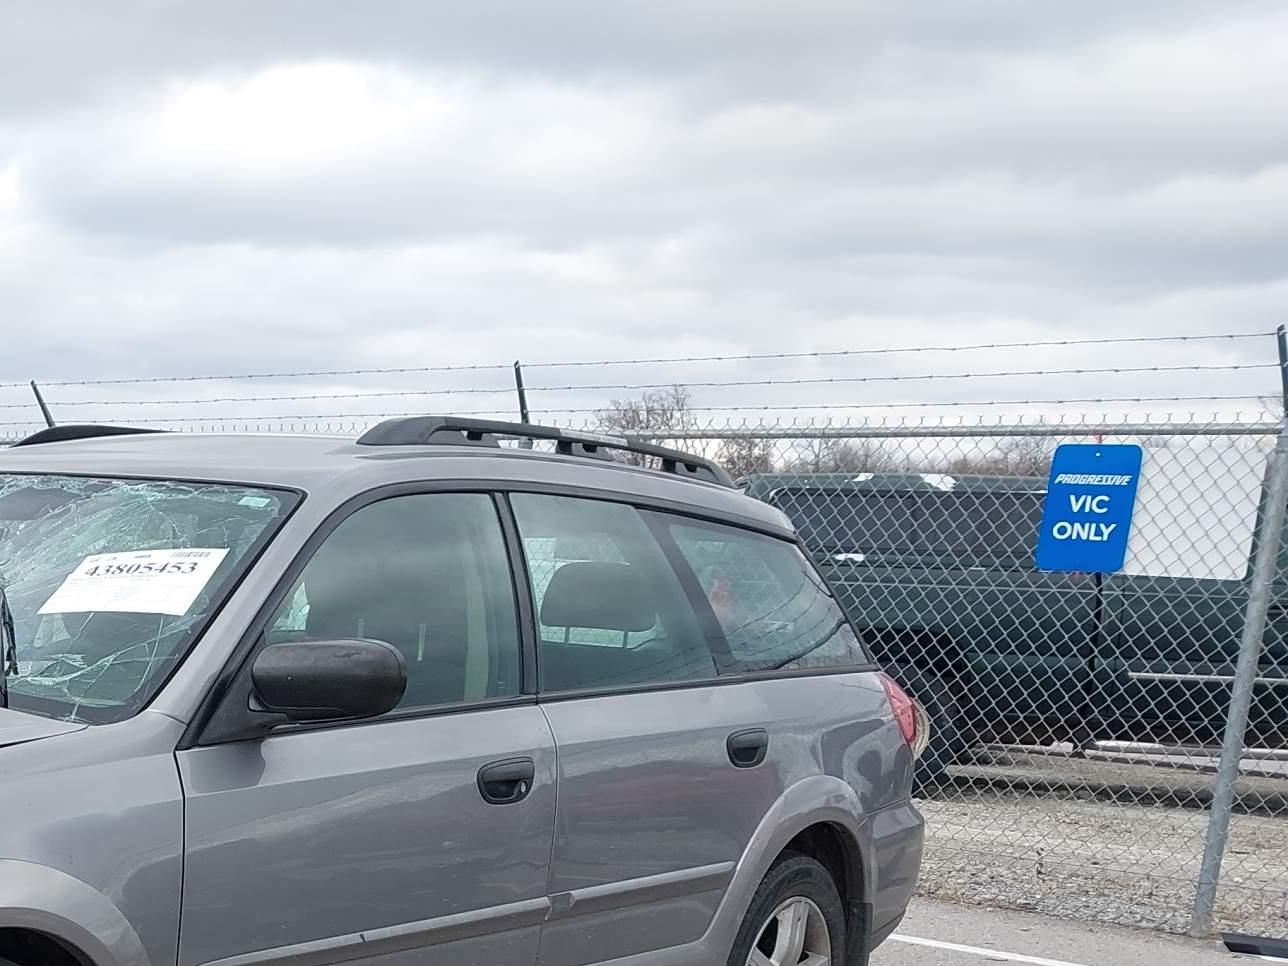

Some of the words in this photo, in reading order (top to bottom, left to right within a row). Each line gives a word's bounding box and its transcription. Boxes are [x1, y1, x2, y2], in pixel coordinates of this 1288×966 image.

[1054, 473, 1133, 486] PROGRESSIVE
[1069, 494, 1111, 514] VIC
[1052, 521, 1118, 541] ONLY
[84, 561, 199, 577] 43805453
